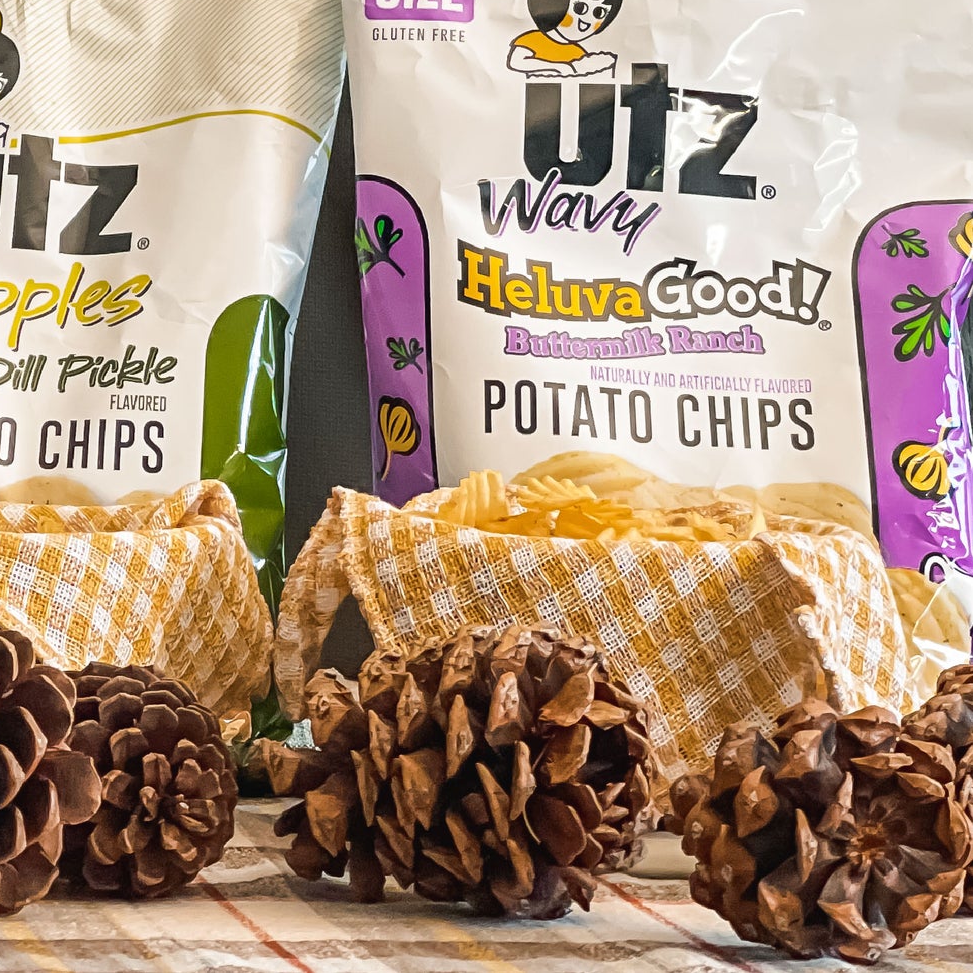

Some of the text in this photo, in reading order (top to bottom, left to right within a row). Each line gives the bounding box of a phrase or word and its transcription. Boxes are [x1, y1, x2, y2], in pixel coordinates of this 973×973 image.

[372, 27, 466, 43] GLUTEN FREE
[478, 167, 663, 255] Wavy
[504, 325, 767, 361] Buttermilk Ranch
[57, 344, 179, 393] Pickle
[590, 364, 812, 395] NATURALLY AND ARTIFICIALLY FLAVORED
[109, 394, 168, 413] FLAVORED
[484, 377, 816, 452] POTATO CHIPS
[37, 418, 165, 474] CHIPS
